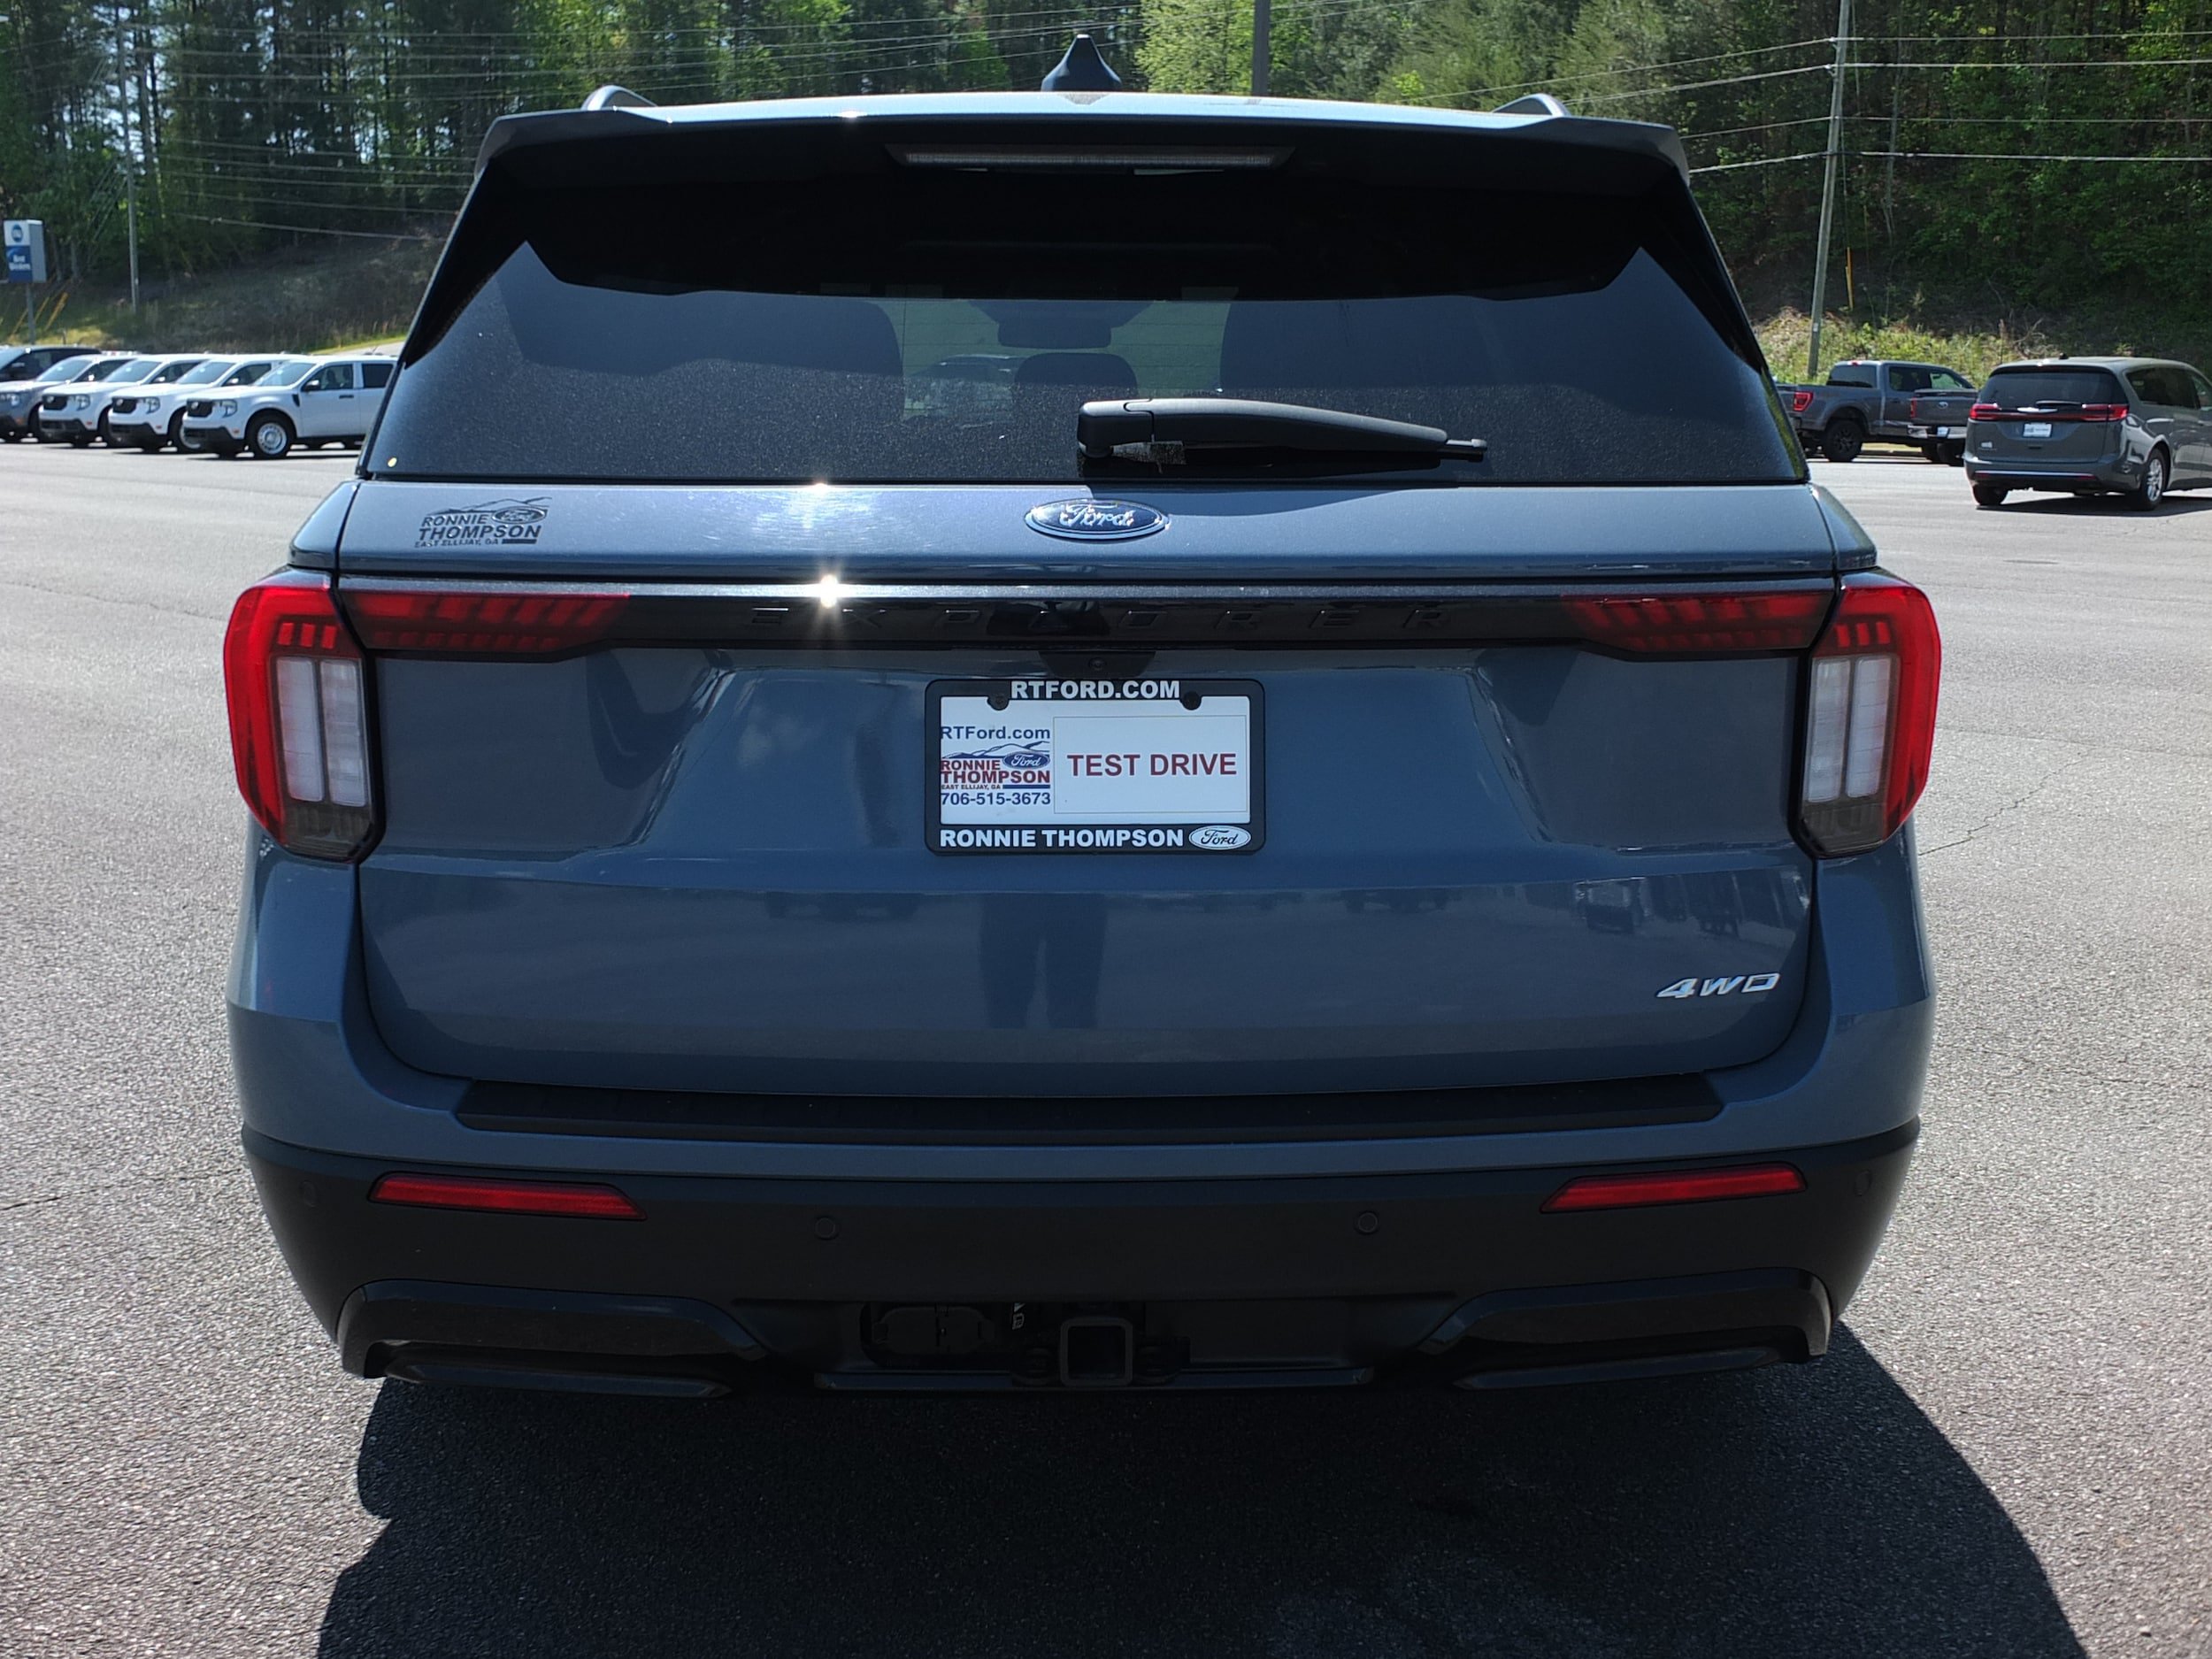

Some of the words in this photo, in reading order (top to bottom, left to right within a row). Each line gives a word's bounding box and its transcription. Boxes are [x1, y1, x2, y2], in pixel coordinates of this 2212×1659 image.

[421, 514, 489, 527] RONNIE
[1059, 503, 1135, 526] Ford
[419, 525, 541, 541] THOMPSON
[1011, 680, 1180, 699] RTFORD.COM
[941, 726, 1050, 740] RTFord.com
[941, 760, 1001, 770] RONNIE
[1010, 754, 1041, 767] Ford
[1067, 755, 1140, 776] TEST
[1151, 754, 1237, 775] DRIVE
[941, 770, 1050, 783] THOMPSON
[941, 792, 1051, 805] 706-515-3673
[940, 829, 1036, 847] RONNIE
[1041, 829, 1183, 847] THOMPSON
[1200, 831, 1238, 846] Ford
[1656, 972, 1781, 999] 4WD
